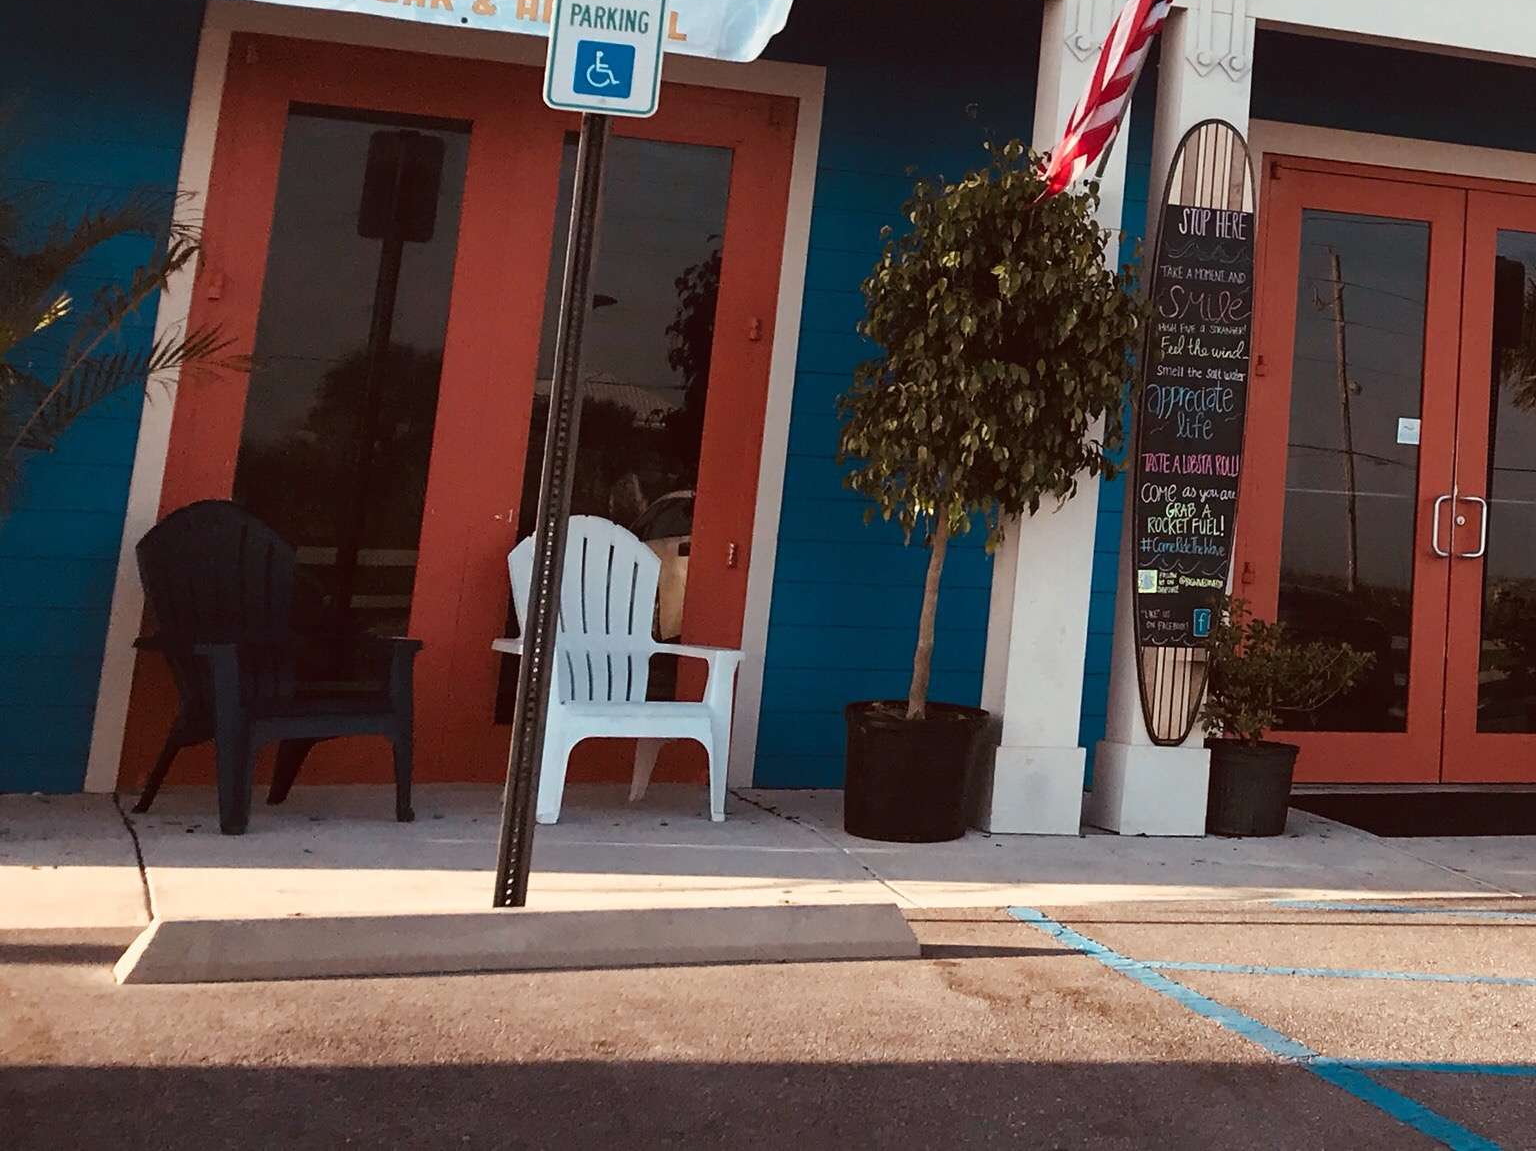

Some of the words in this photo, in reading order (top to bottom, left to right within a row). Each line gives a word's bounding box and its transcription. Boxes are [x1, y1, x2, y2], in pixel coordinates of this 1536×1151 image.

[570, 3, 650, 34] PARKING
[1179, 208, 1211, 236] STOP
[1216, 211, 1248, 240] HERE
[1160, 265, 1183, 279] TAKE
[1187, 337, 1210, 357] the
[1187, 366, 1202, 379] the
[1147, 381, 1234, 420] appreciate
[1176, 411, 1214, 441] life
[1171, 454, 1181, 474] A
[1182, 486, 1197, 498] as
[1199, 488, 1220, 503] you
[1165, 502, 1197, 518] GRAB
[1202, 504, 1212, 518] A
[1147, 516, 1190, 536] ROCKET
[1191, 514, 1225, 537] FUEL!
